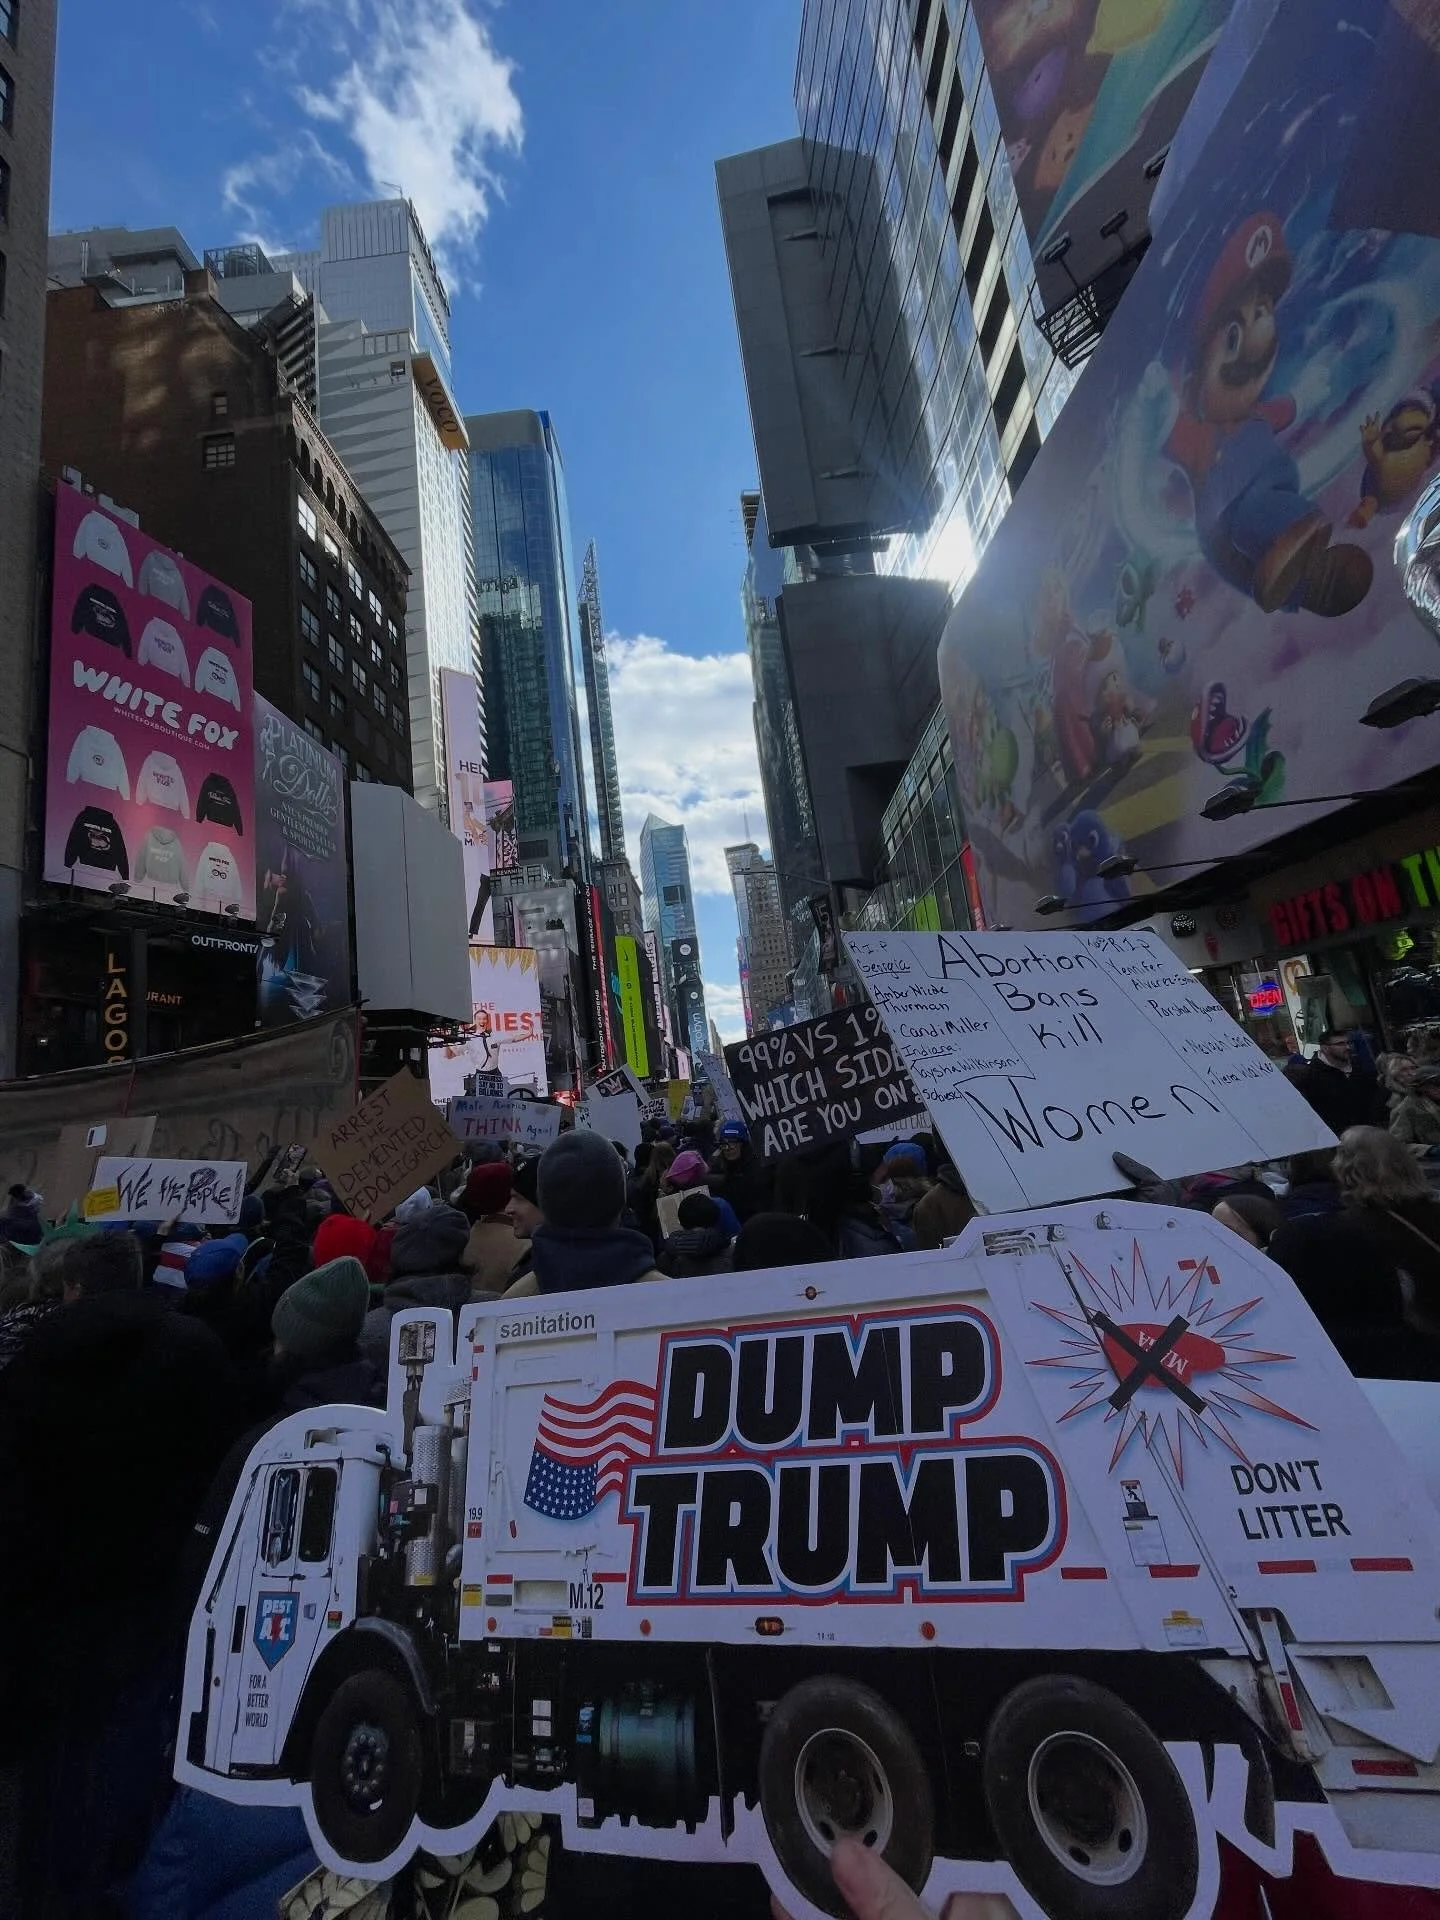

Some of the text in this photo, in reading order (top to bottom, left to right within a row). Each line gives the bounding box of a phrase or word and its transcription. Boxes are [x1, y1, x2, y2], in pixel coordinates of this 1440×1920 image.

[73, 659, 239, 751] WHITE FOX
[113, 706, 210, 750] WHITEFOXBOUTIQUE.COM
[1268, 882, 1350, 946] GIFTS
[1351, 863, 1402, 924] ON
[937, 933, 1098, 980] Abortion
[472, 1002, 495, 1011] THE
[871, 984, 909, 1001] Amber
[876, 998, 950, 1014] Thurman
[993, 982, 1099, 1012] Bans
[1249, 987, 1283, 1008] OPEN
[486, 1012, 542, 1032] IES
[691, 1012, 703, 1043] robyn
[899, 1016, 990, 1039] Candi Miller
[738, 1032, 796, 1073] 99%
[792, 1021, 838, 1060] VS
[736, 1066, 828, 1121] WHICH
[835, 1043, 907, 1089] SIDE
[331, 1088, 391, 1151] ARREST
[463, 1117, 522, 1137] THINK
[763, 1110, 814, 1158] ARE
[816, 1096, 862, 1135] YOU
[963, 1076, 1224, 1154] Women
[355, 1119, 389, 1148] THE
[337, 1115, 425, 1193] DEMENTED
[343, 1123, 453, 1214] PEDOLIGARCH
[499, 1312, 596, 1339] sanitation
[660, 1316, 990, 1452] DUMP
[1230, 1459, 1324, 1495] DON'T
[630, 1451, 1054, 1592] TRUMP
[1237, 1502, 1353, 1541] LITTER
[568, 1582, 604, 1610] M.12
[248, 1674, 267, 1689] FOR A
[246, 1692, 269, 1709] BETTER
[244, 1712, 269, 1728] WORLD
